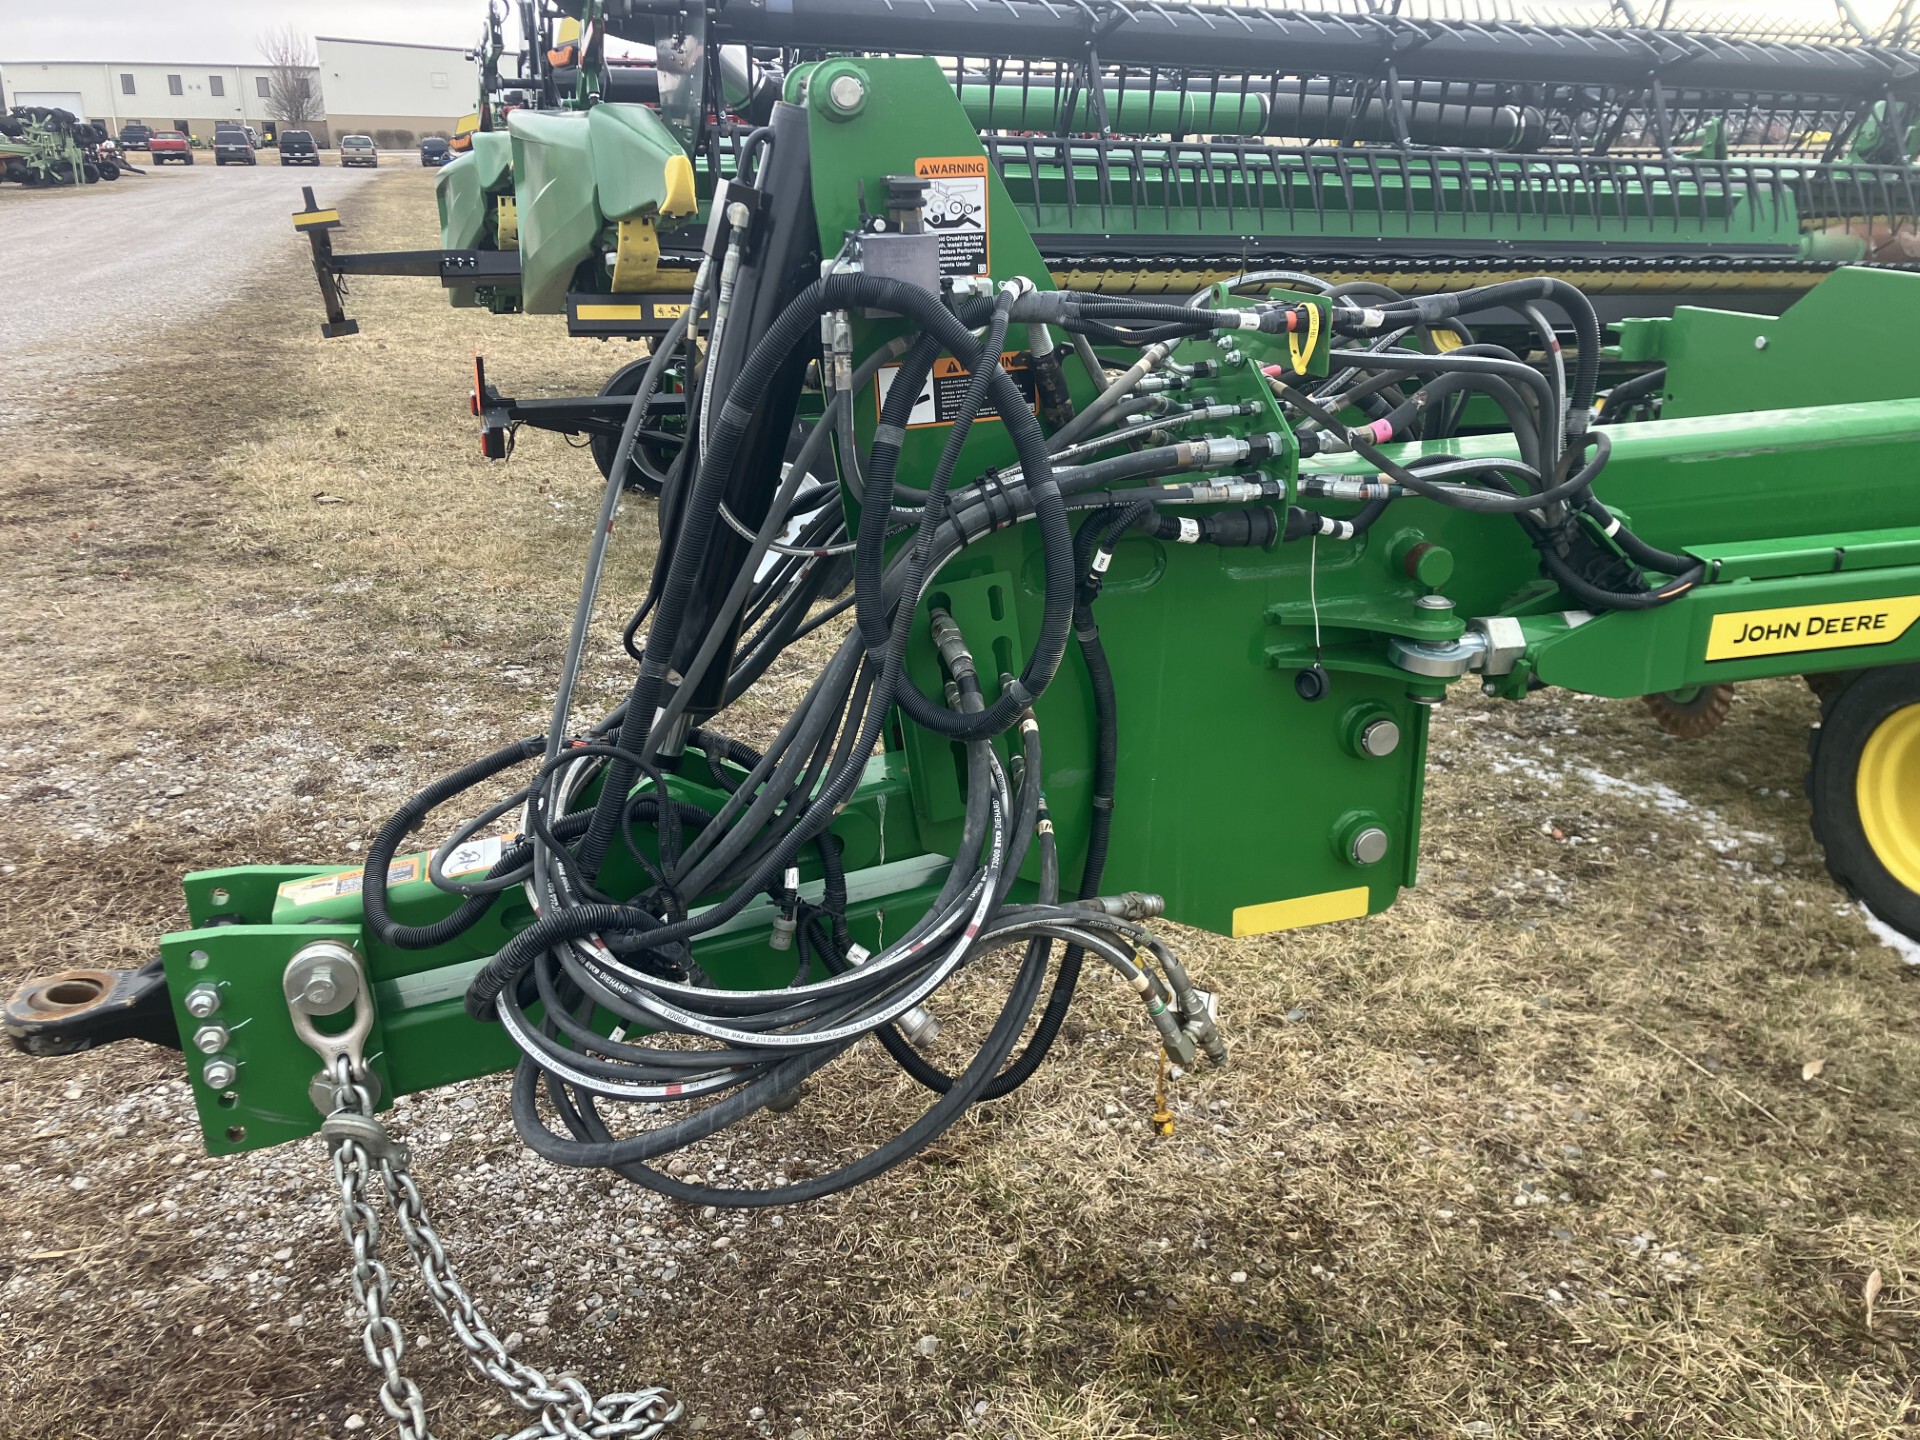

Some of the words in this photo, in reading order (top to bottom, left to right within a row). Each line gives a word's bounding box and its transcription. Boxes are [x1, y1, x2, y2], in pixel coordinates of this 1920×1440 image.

[930, 163, 984, 174] WARNING
[1098, 557, 1106, 569] FUSE
[1733, 622, 1801, 644] JOHN
[1806, 613, 1889, 636] DEERE
[994, 798, 1002, 829] DIEHARD
[994, 830, 1002, 848] RYCO
[991, 847, 1000, 869] T3000
[968, 881, 983, 901] T3000
[1088, 920, 1120, 932] DIEHARD
[585, 961, 600, 975] RYCO
[600, 971, 632, 995] DIEHARD
[662, 1008, 688, 1025] T3006D
[714, 1027, 729, 1038] DN10
[813, 1033, 831, 1041] MSHA
[860, 1018, 876, 1029] FRAS
[883, 998, 912, 1019] ABRASION
[911, 974, 939, 999] RESISTANT
[510, 1025, 521, 1039] MSHA
[536, 1051, 550, 1064] FRAS
[553, 1064, 581, 1081] ABRASION
[581, 1077, 614, 1091] RESISTANT
